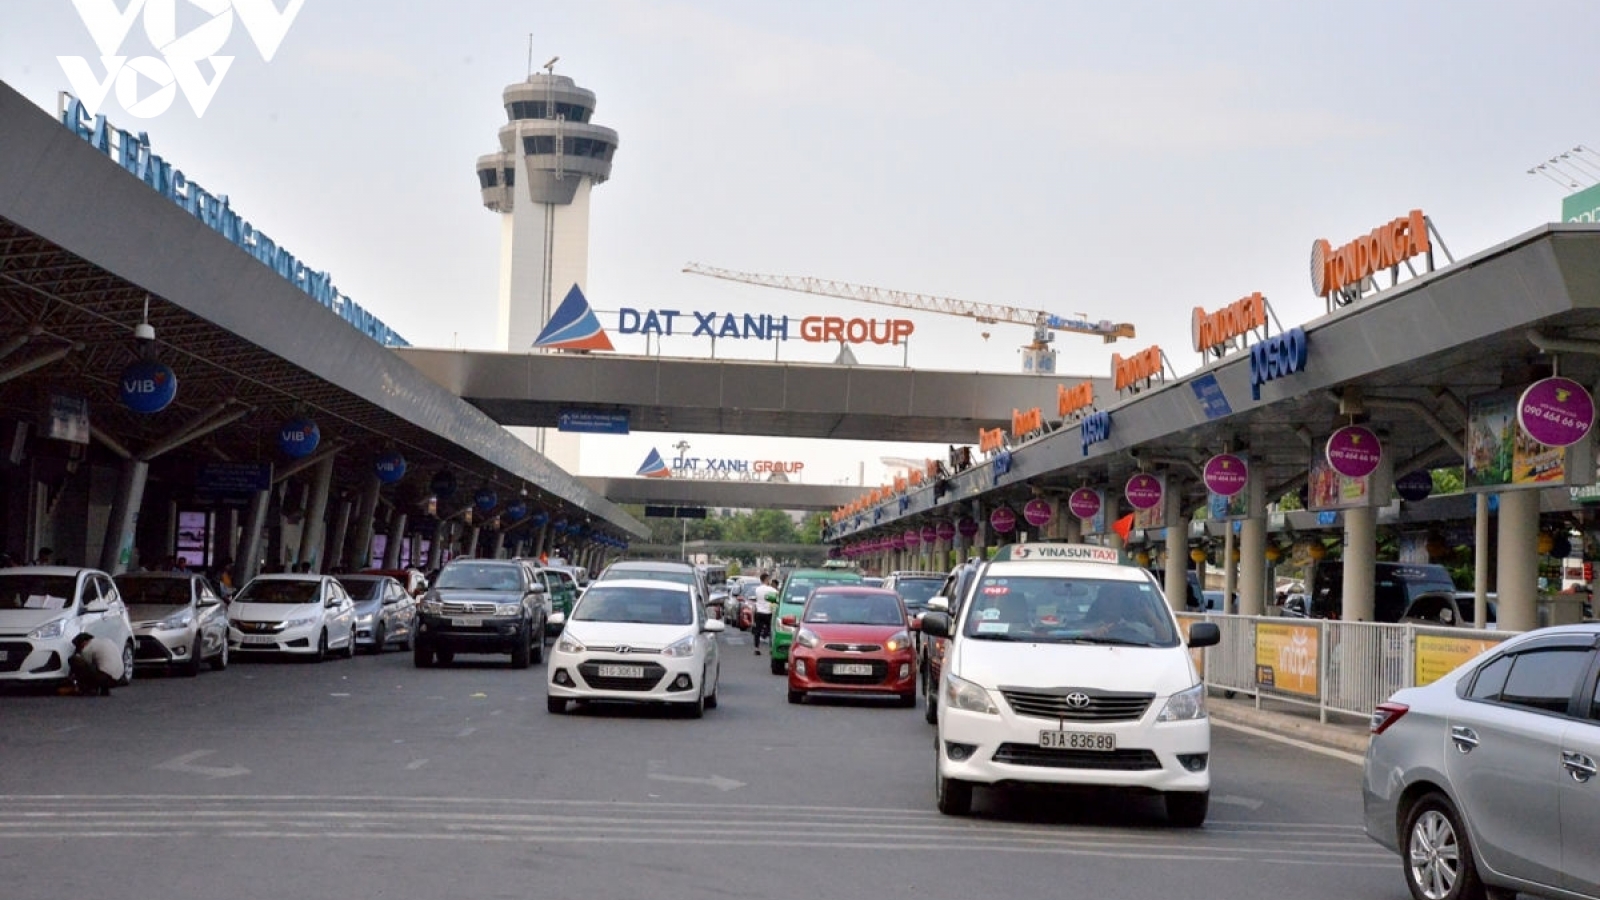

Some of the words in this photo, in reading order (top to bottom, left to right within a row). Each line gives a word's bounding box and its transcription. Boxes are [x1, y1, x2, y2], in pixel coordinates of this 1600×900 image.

[619, 308, 680, 336] DAT
[692, 311, 788, 341] XANH
[800, 316, 914, 345] GROUP
[1250, 327, 1307, 401] posco
[123, 379, 155, 393] VIB
[1524, 404, 1542, 417] 090
[1543, 411, 1561, 423] 464
[1562, 417, 1574, 428] 66
[1575, 421, 1588, 431] 99
[282, 431, 305, 441] VIB
[673, 457, 700, 470] DAT
[706, 458, 748, 471] XANH
[753, 460, 804, 473] GROUP
